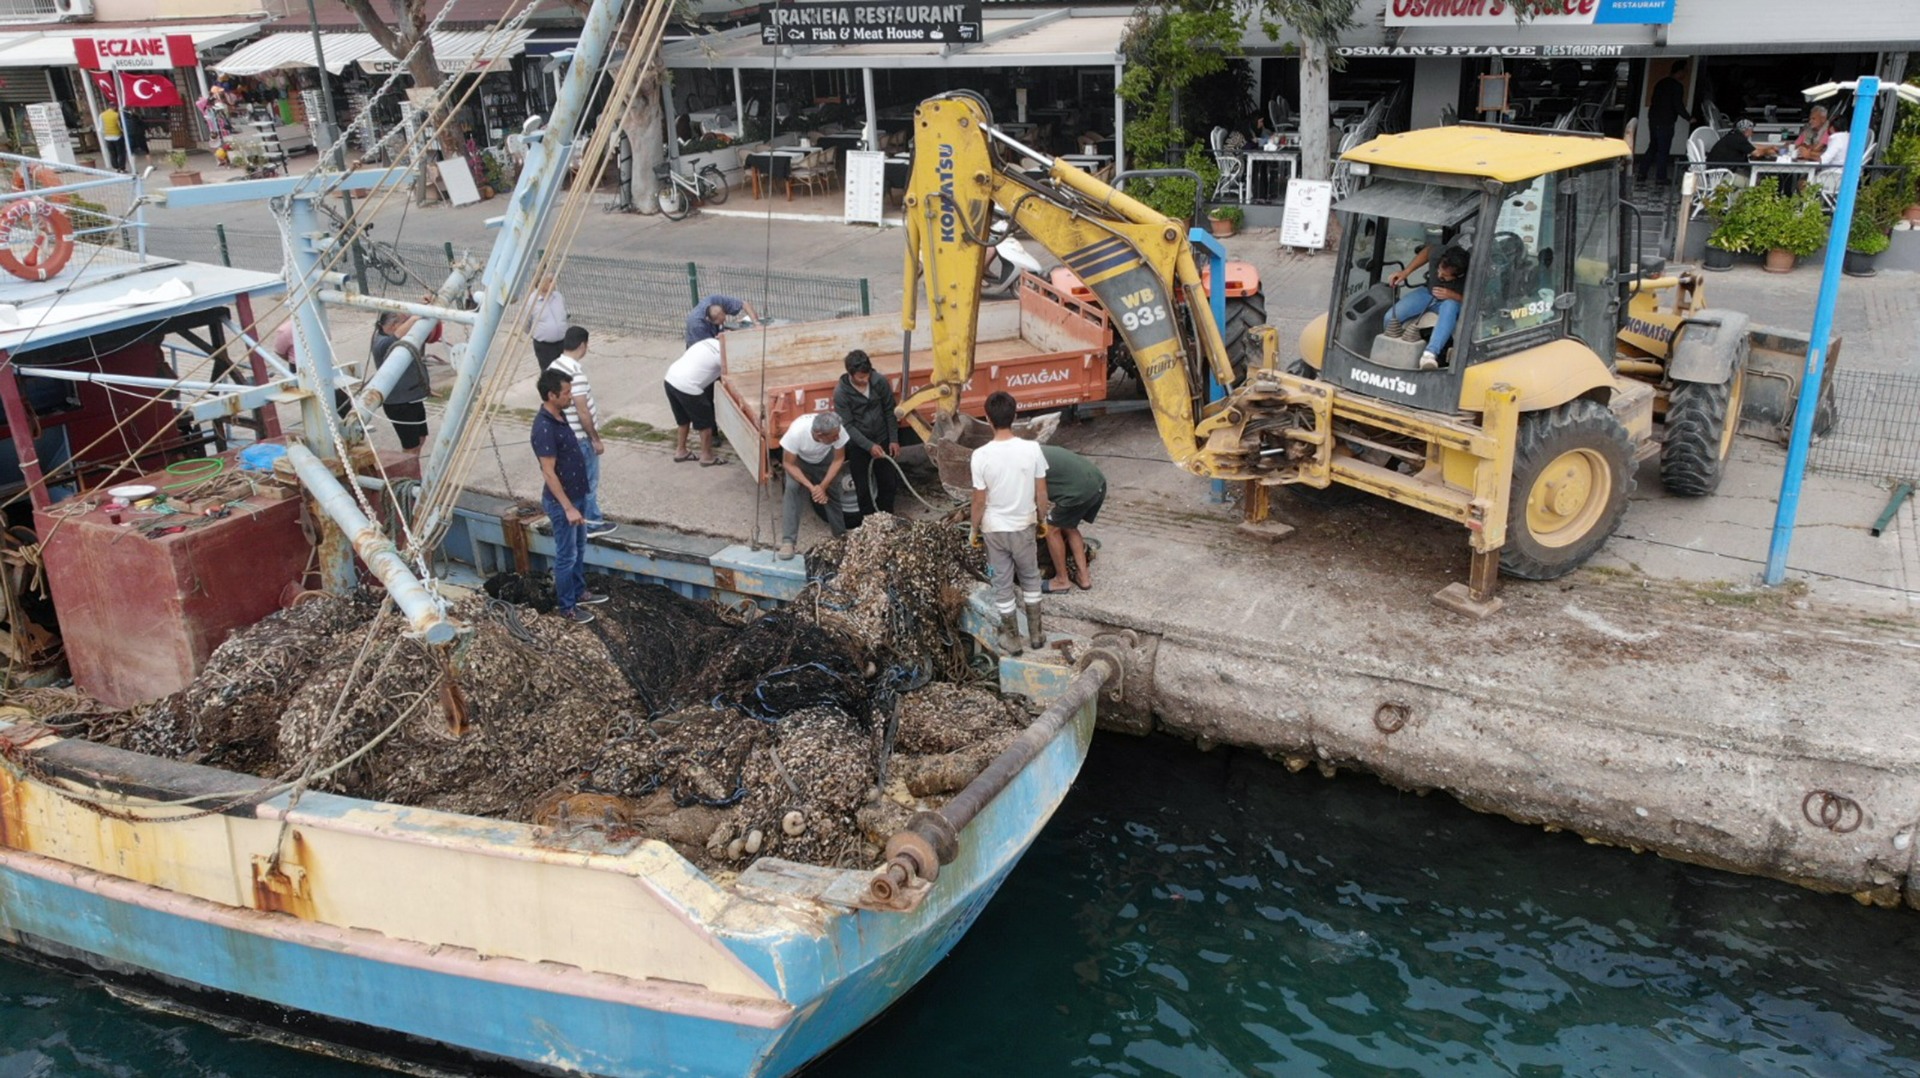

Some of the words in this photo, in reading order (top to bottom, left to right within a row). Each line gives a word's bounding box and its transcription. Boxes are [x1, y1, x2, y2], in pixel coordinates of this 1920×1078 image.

[1393, 0, 1505, 17] Osmans
[1612, 1, 1665, 9] RESTAURANT
[768, 8, 849, 26] TRAKHEIA
[854, 5, 965, 25] RESTAURANT
[812, 27, 837, 40] Fish
[840, 27, 850, 40] &
[853, 27, 883, 40] Meat
[886, 26, 924, 39] House
[97, 38, 165, 57] ECZANE
[1336, 46, 1447, 56] OSMAN'S
[1450, 46, 1536, 56] PLACE
[1543, 45, 1624, 56] RESTAURANT
[937, 144, 954, 242] KOMATSU
[1121, 288, 1155, 309] WB
[1122, 305, 1166, 331] 93s
[1624, 316, 1674, 343] KOMATSU
[1005, 368, 1069, 387] YATAĞAN
[1351, 368, 1417, 395] KOMATSU
